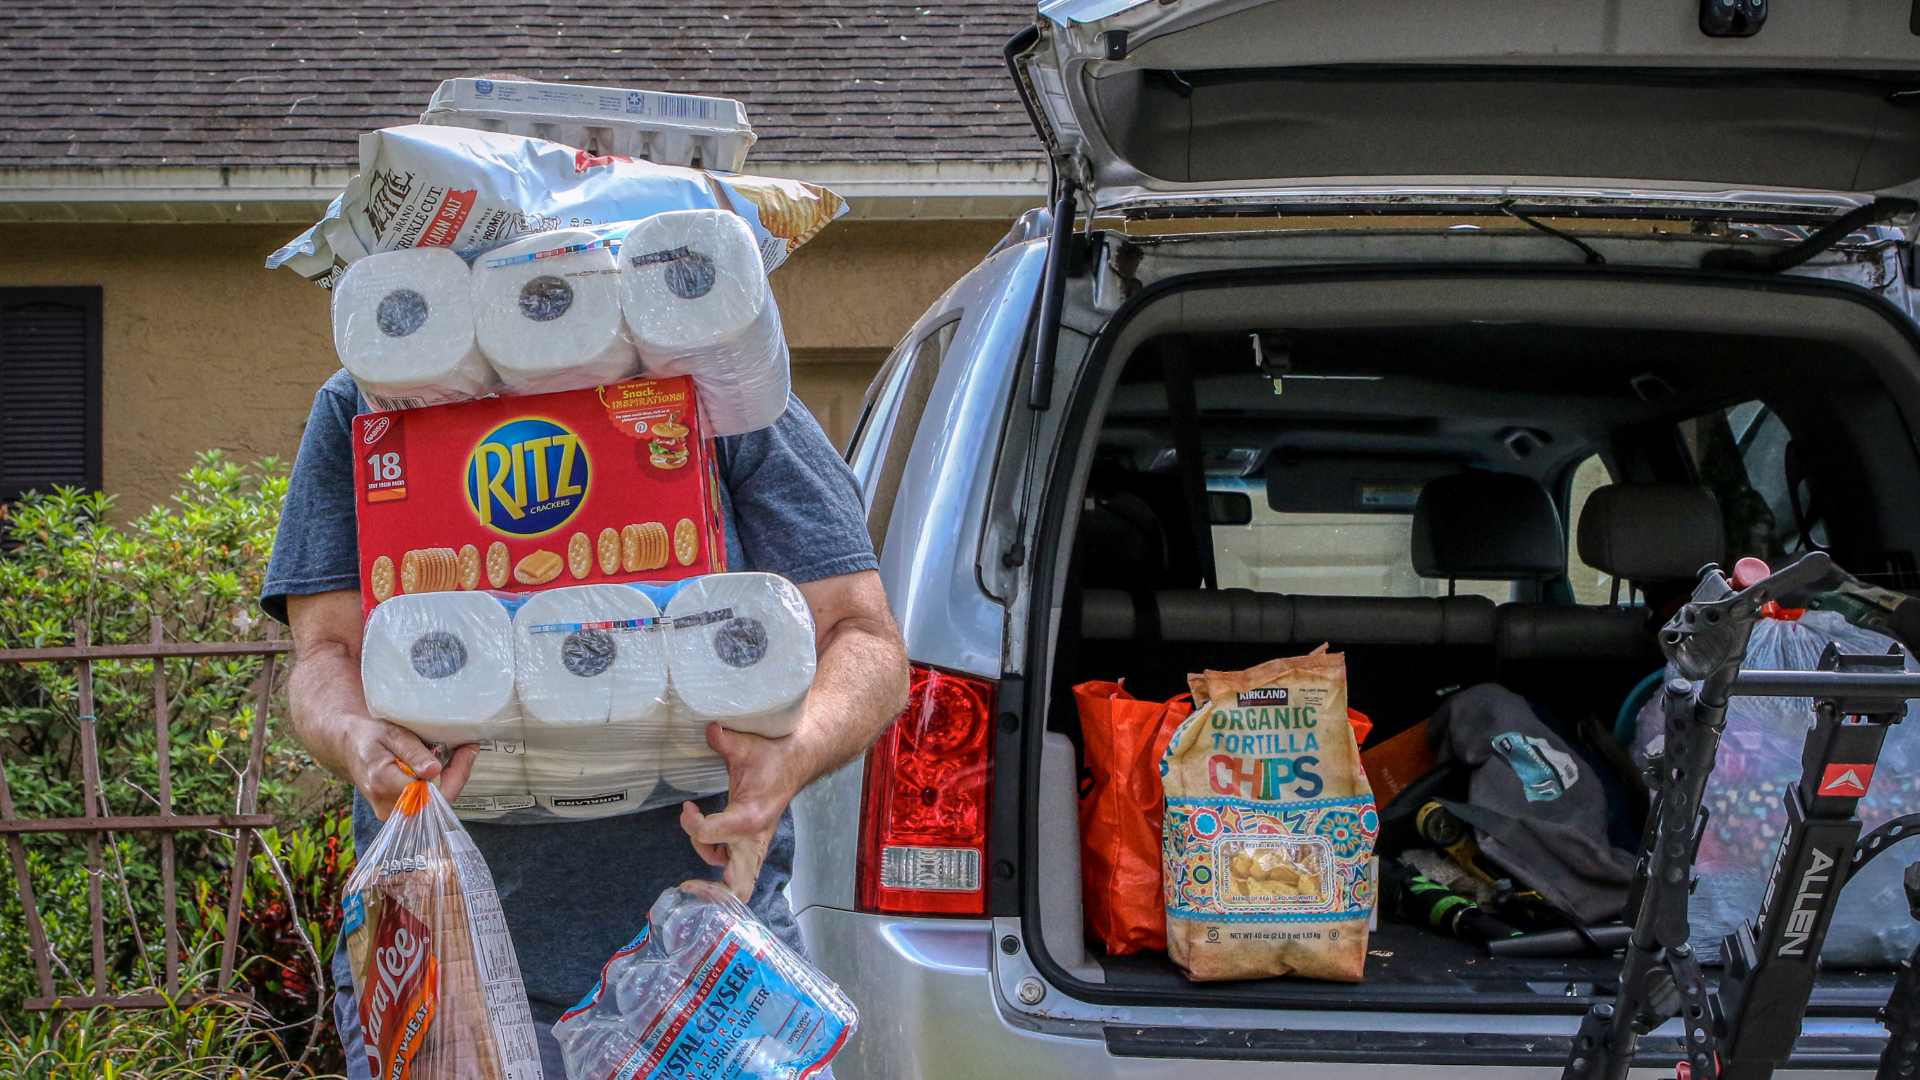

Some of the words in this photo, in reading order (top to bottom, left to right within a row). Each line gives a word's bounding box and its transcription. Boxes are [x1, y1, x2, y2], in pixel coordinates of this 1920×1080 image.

[393, 204, 415, 232] BRAND
[442, 197, 463, 219] SALT
[484, 209, 507, 241] PROMISE
[612, 392, 685, 409] INSPIRATIONS!
[623, 387, 654, 399] Snack
[366, 420, 388, 442] NABISCO
[368, 452, 402, 481] 18
[475, 434, 582, 526] RITZ
[530, 499, 571, 514] CRACKERS
[1240, 690, 1286, 700] KIRKLAND
[1212, 706, 1318, 730] ORGANIC
[1212, 732, 1320, 754] TORTILLA
[1209, 754, 1323, 800] CHIPS
[1778, 847, 1834, 956] ALLEN
[1314, 932, 1320, 940] kg
[377, 927, 423, 1005] Lee
[697, 959, 756, 1035] GEYSER
[399, 1002, 428, 1051] WHEAT
[642, 1036, 672, 1073] BOTTLED
[672, 1022, 682, 1034] AT
[682, 1004, 697, 1024] THE
[698, 966, 722, 1001] SOURCE
[707, 1027, 743, 1074] SPRING
[739, 986, 770, 1034] WATER
[685, 1008, 743, 1079] NATURAL
[725, 1063, 734, 1073] CG
[731, 1040, 750, 1064] ROXANE
